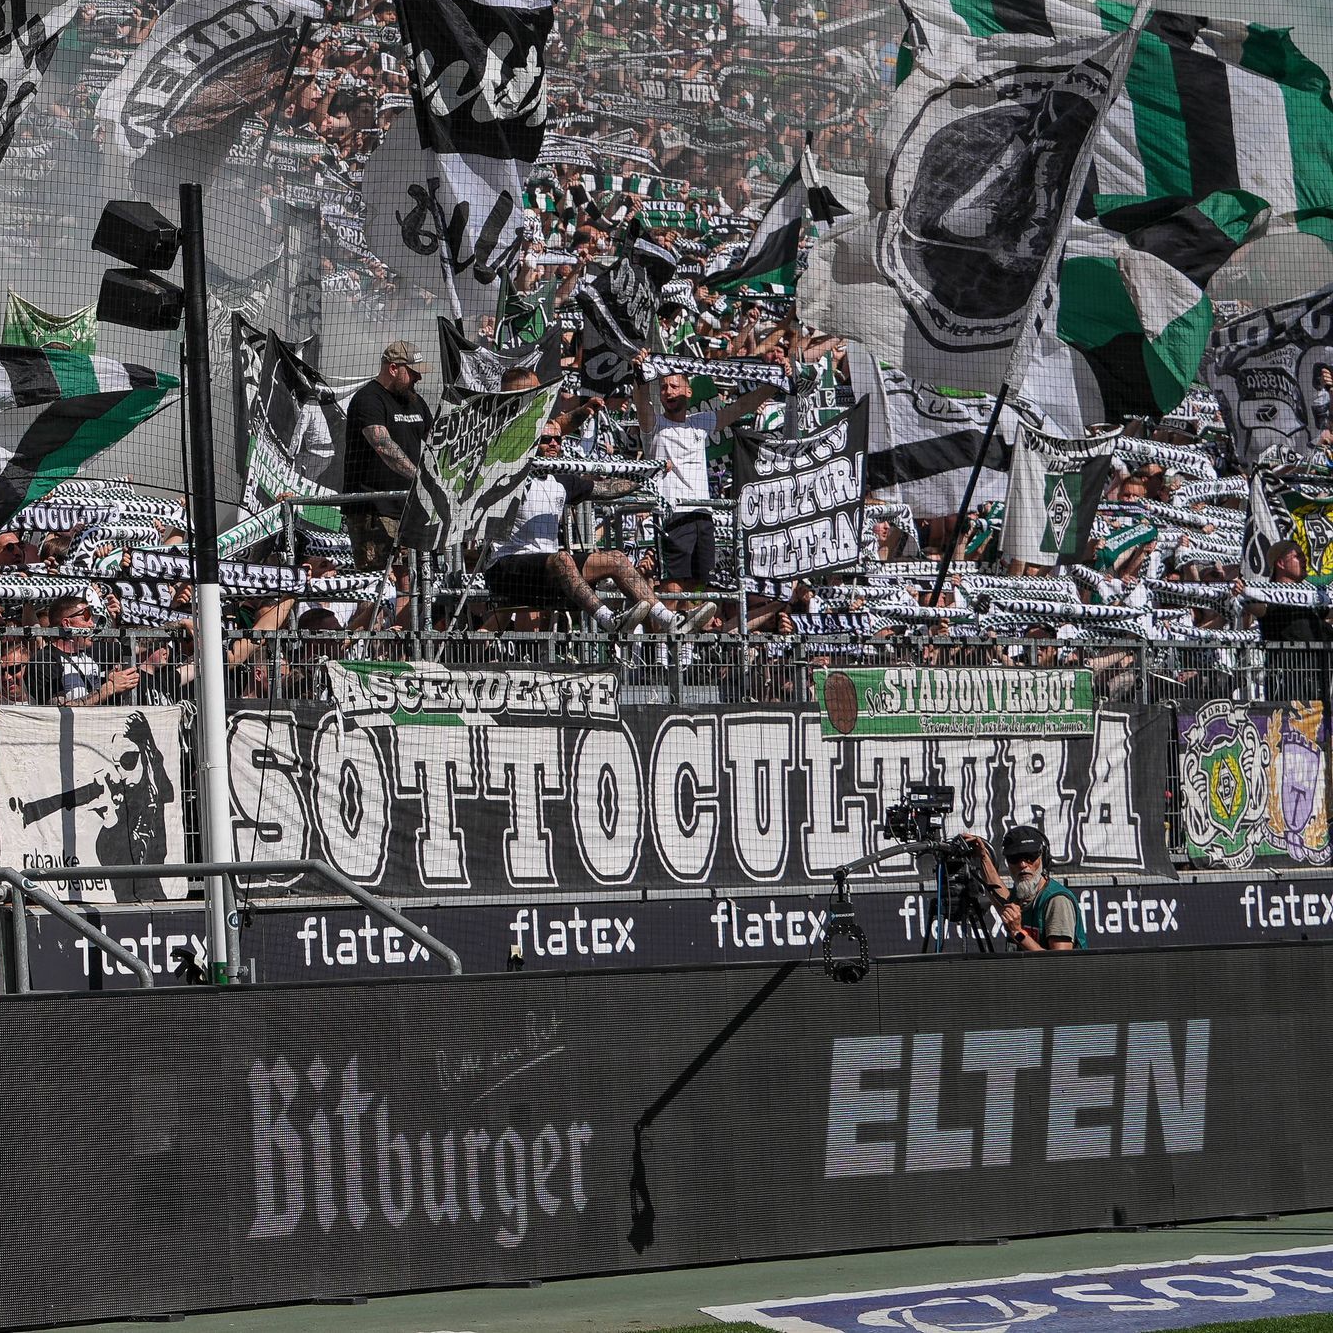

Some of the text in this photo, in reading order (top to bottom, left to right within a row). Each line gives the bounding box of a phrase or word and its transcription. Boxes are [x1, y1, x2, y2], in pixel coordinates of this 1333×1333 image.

[509, 908, 635, 957] flatex
[710, 899, 827, 950] flatex
[246, 1052, 595, 1249] Bitburger
[824, 1018, 1212, 1180] ELTEN
